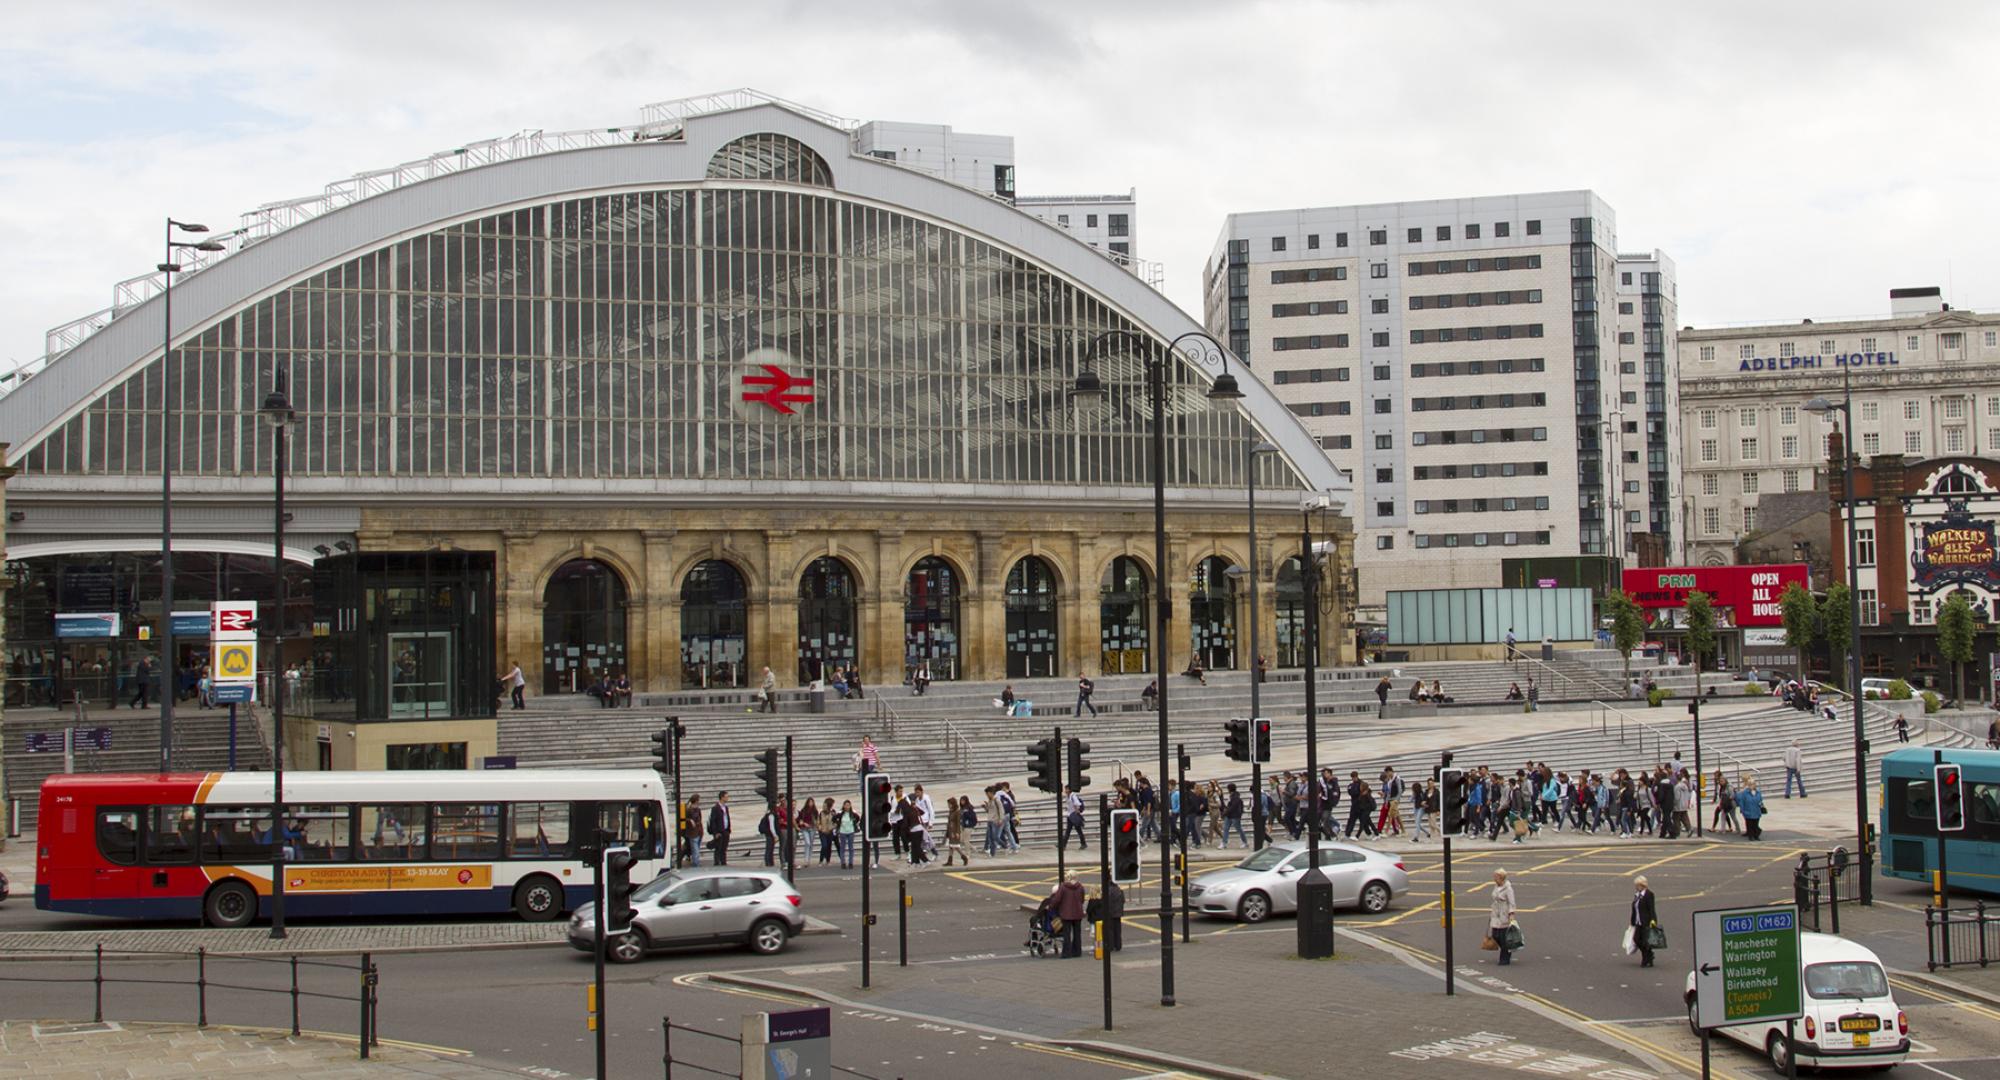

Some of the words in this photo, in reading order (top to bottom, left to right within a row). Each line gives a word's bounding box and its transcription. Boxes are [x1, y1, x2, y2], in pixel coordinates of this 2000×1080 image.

[1739, 355, 1822, 371] ADELPHI
[1835, 352, 1899, 367] HOTEL
[1944, 542, 1976, 553] ALES
[1927, 548, 1993, 564] WARRINGTON
[1658, 574, 1696, 588] PRM
[1751, 573, 1779, 586] OPEN
[1636, 591, 1670, 601] NEWS
[1674, 591, 1682, 601] &
[1752, 588, 1771, 601] ALL
[310, 869, 359, 878] CHRISTIAN
[361, 869, 378, 877] AID
[407, 868, 428, 876] 13-19
[428, 868, 449, 876] MAY
[1725, 918, 1753, 932] (M6)
[1758, 915, 1791, 929] (M62)
[1725, 938, 1778, 950] Manchester
[1725, 951, 1777, 962] Warrington
[1726, 967, 1767, 977] Wallasey
[1727, 976, 1779, 991] Birkenhead
[1728, 988, 1773, 1004] (Tunnels)
